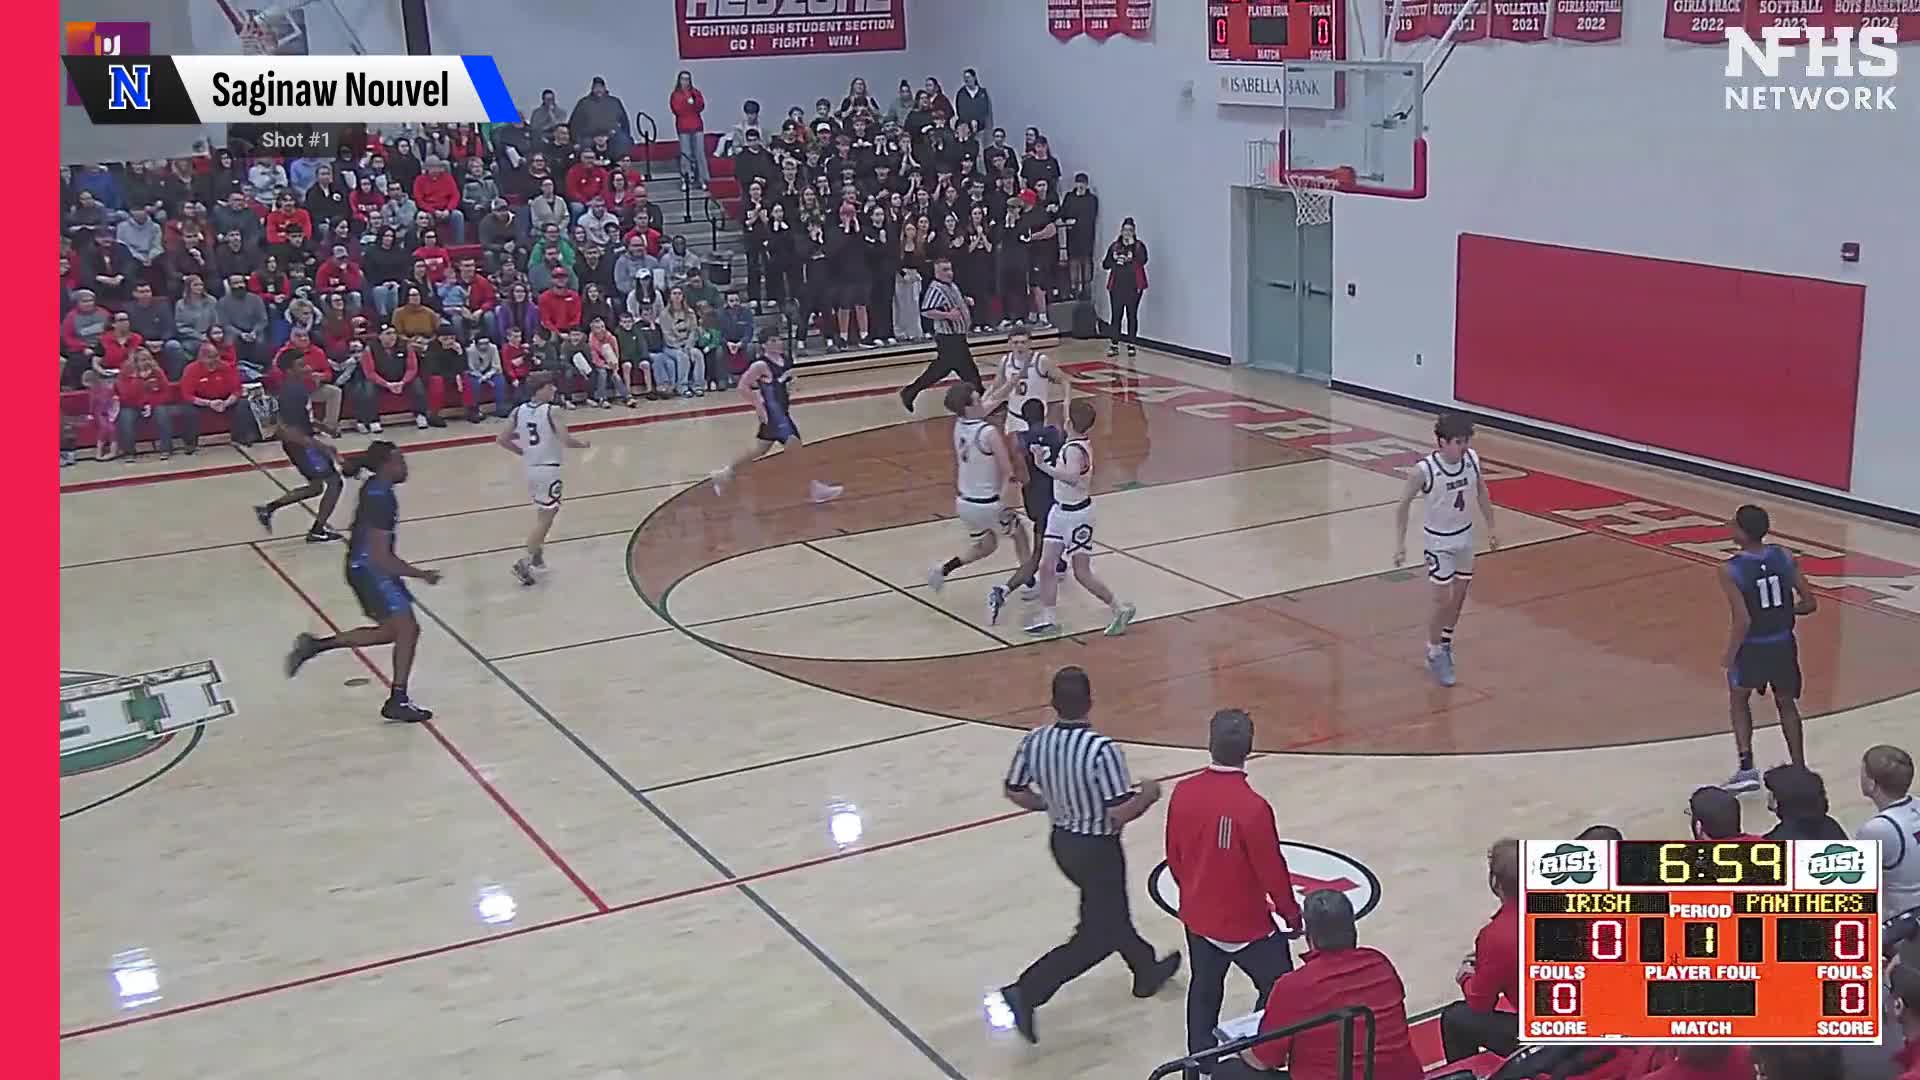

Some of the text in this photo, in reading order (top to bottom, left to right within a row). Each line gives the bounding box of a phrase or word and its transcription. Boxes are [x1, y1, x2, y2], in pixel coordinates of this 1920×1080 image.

[1494, 2, 1548, 15] VOLLEYBA
[1760, 0, 1823, 13] SOFTBALL
[690, 19, 895, 37] FIGHTING IRISH STUDENT SECTION
[1216, 18, 1226, 43] 0
[1318, 18, 1328, 44] 0
[1512, 18, 1539, 31] 2021
[1577, 17, 1606, 30] 2022
[1692, 17, 1724, 31] 2022
[1230, 76, 1282, 95] ISABELLA
[526, 422, 540, 446] 3
[1454, 490, 1466, 511] 4
[1756, 575, 1783, 609] 11
